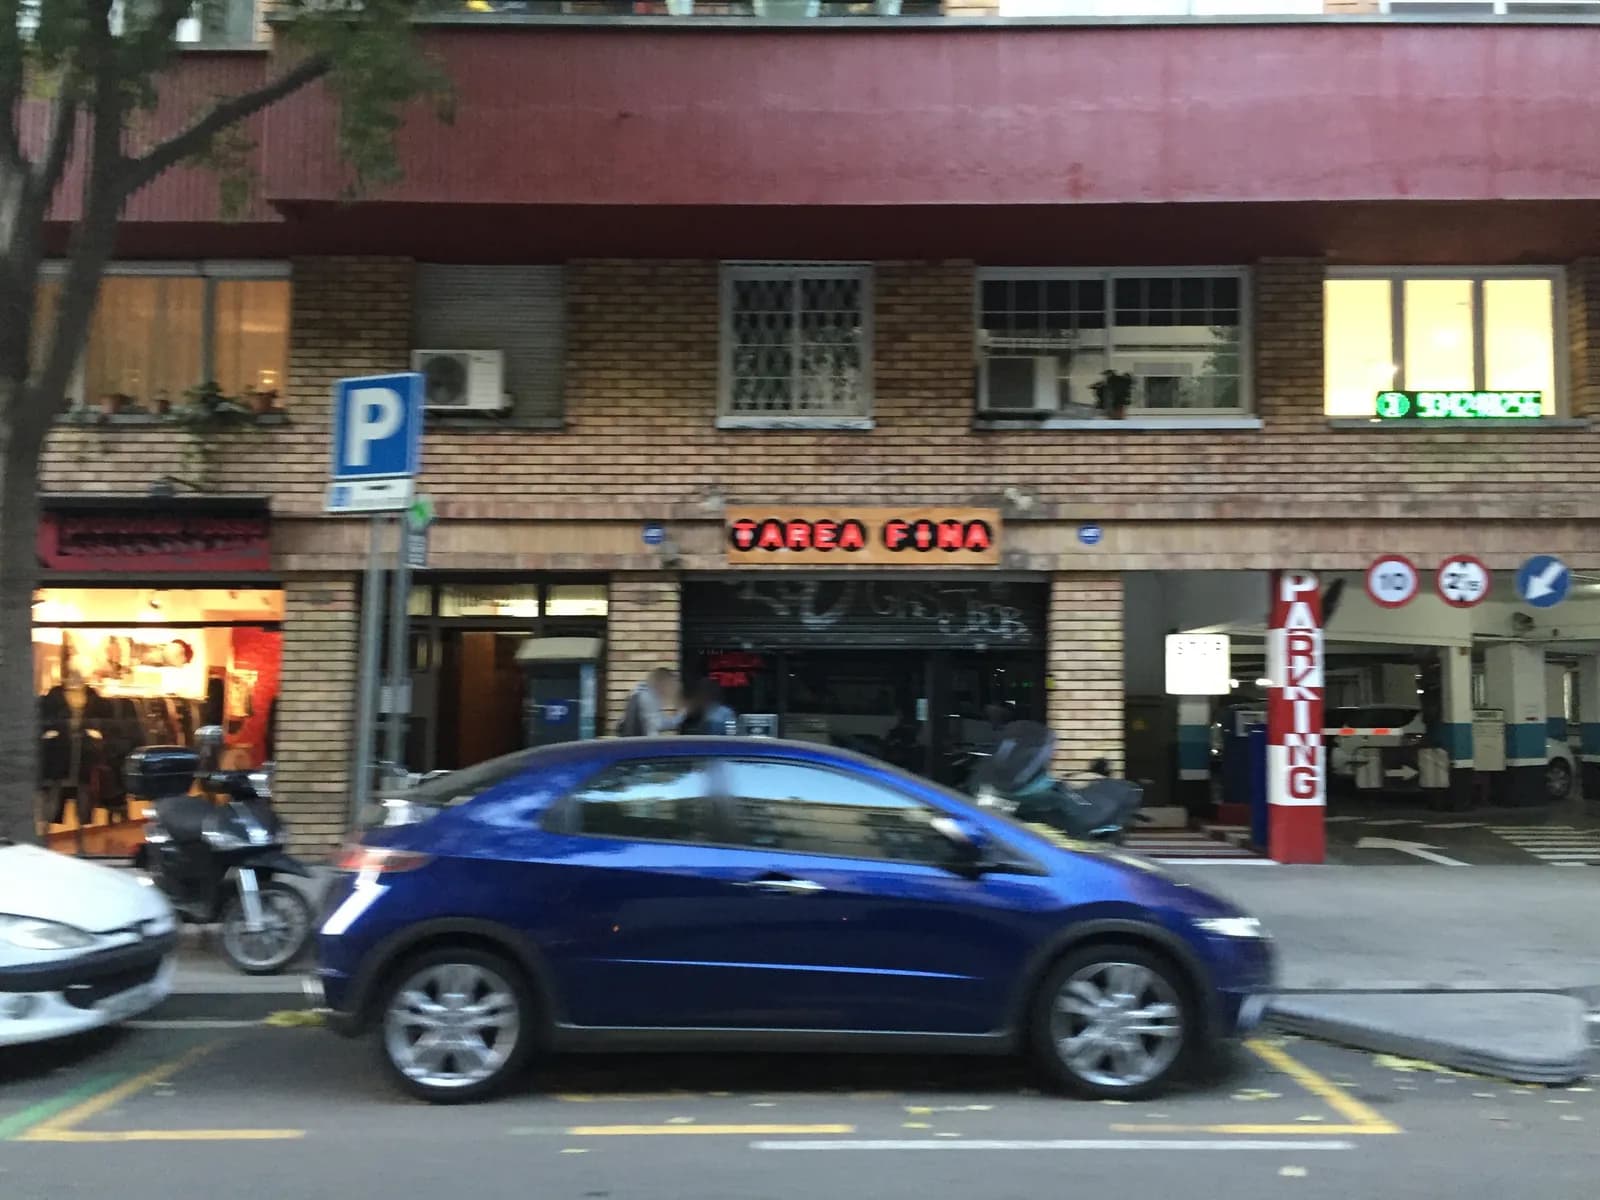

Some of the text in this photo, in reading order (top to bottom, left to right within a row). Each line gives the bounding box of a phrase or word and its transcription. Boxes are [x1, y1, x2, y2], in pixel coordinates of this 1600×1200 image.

[345, 387, 404, 466] P
[732, 522, 992, 549] TAREA FINA
[1380, 572, 1409, 591] 10
[1281, 574, 1320, 800] PARKING
